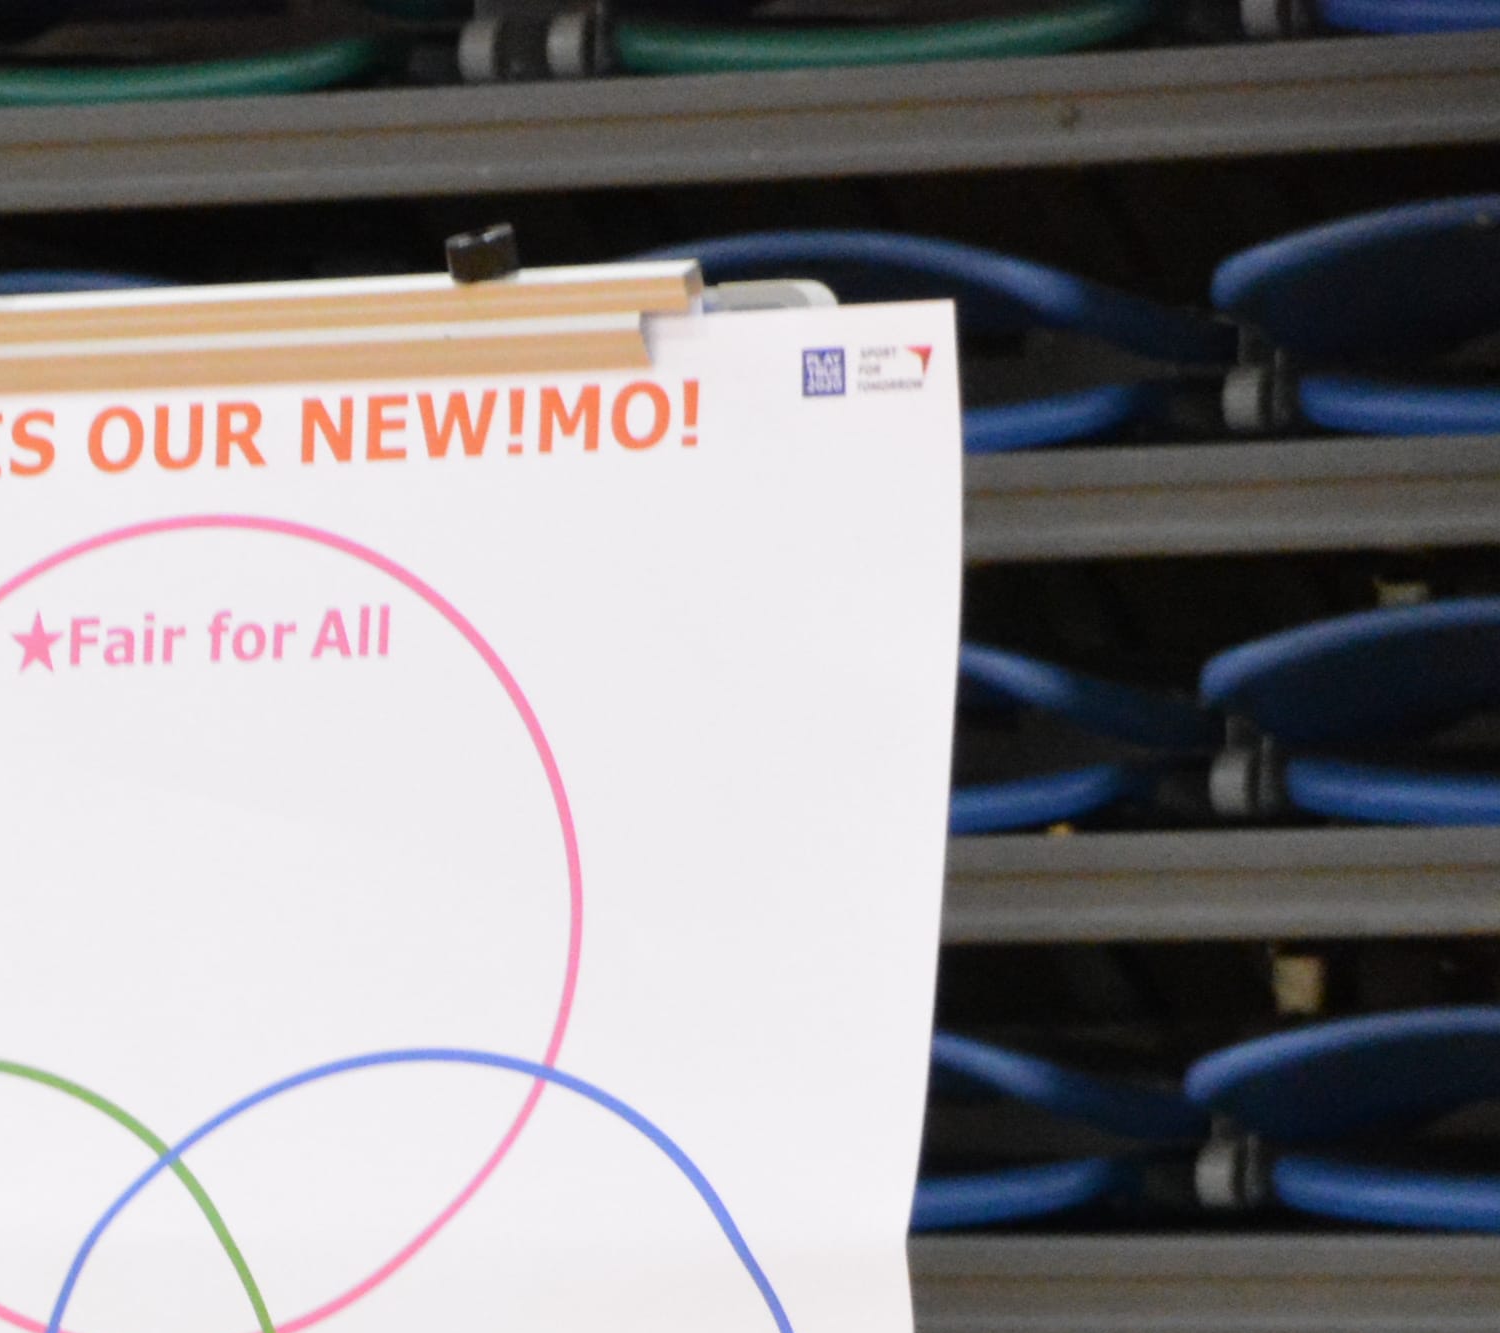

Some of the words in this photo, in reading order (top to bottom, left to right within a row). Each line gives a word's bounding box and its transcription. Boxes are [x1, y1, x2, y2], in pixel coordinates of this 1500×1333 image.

[89, 402, 268, 476] OUR
[302, 380, 702, 466] NEW!MO!
[68, 613, 190, 669] Fair
[208, 609, 300, 665] for
[312, 604, 393, 661] All
